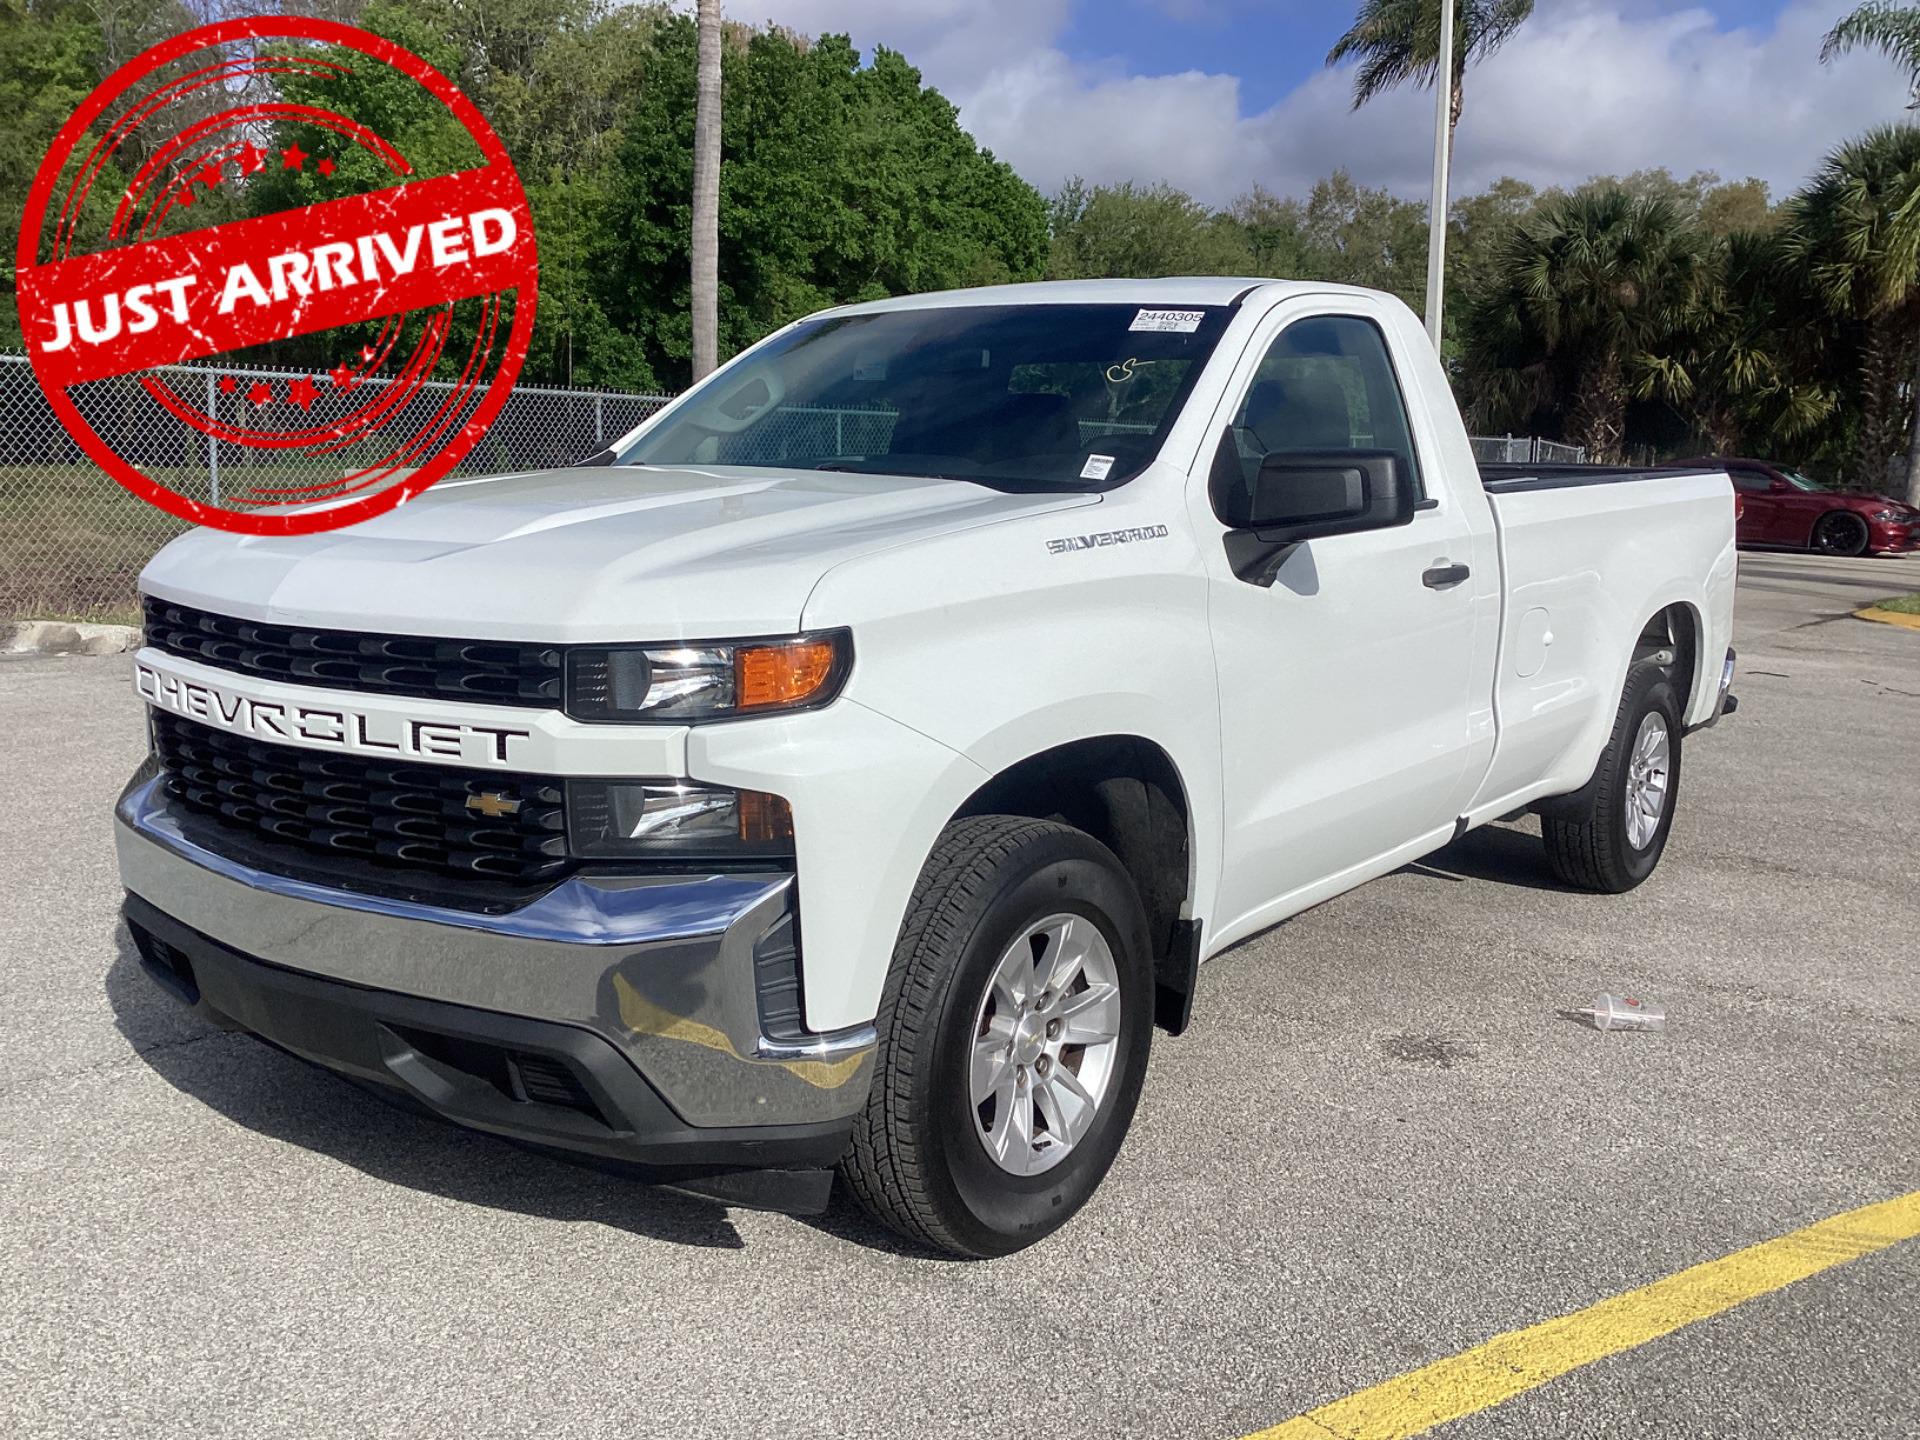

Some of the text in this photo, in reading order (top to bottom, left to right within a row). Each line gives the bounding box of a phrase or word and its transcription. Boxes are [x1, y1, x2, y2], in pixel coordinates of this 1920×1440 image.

[1137, 312, 1203, 322] 2440305
[1046, 524, 1169, 554] SILVERADO
[135, 664, 530, 766] CHEVROLET
